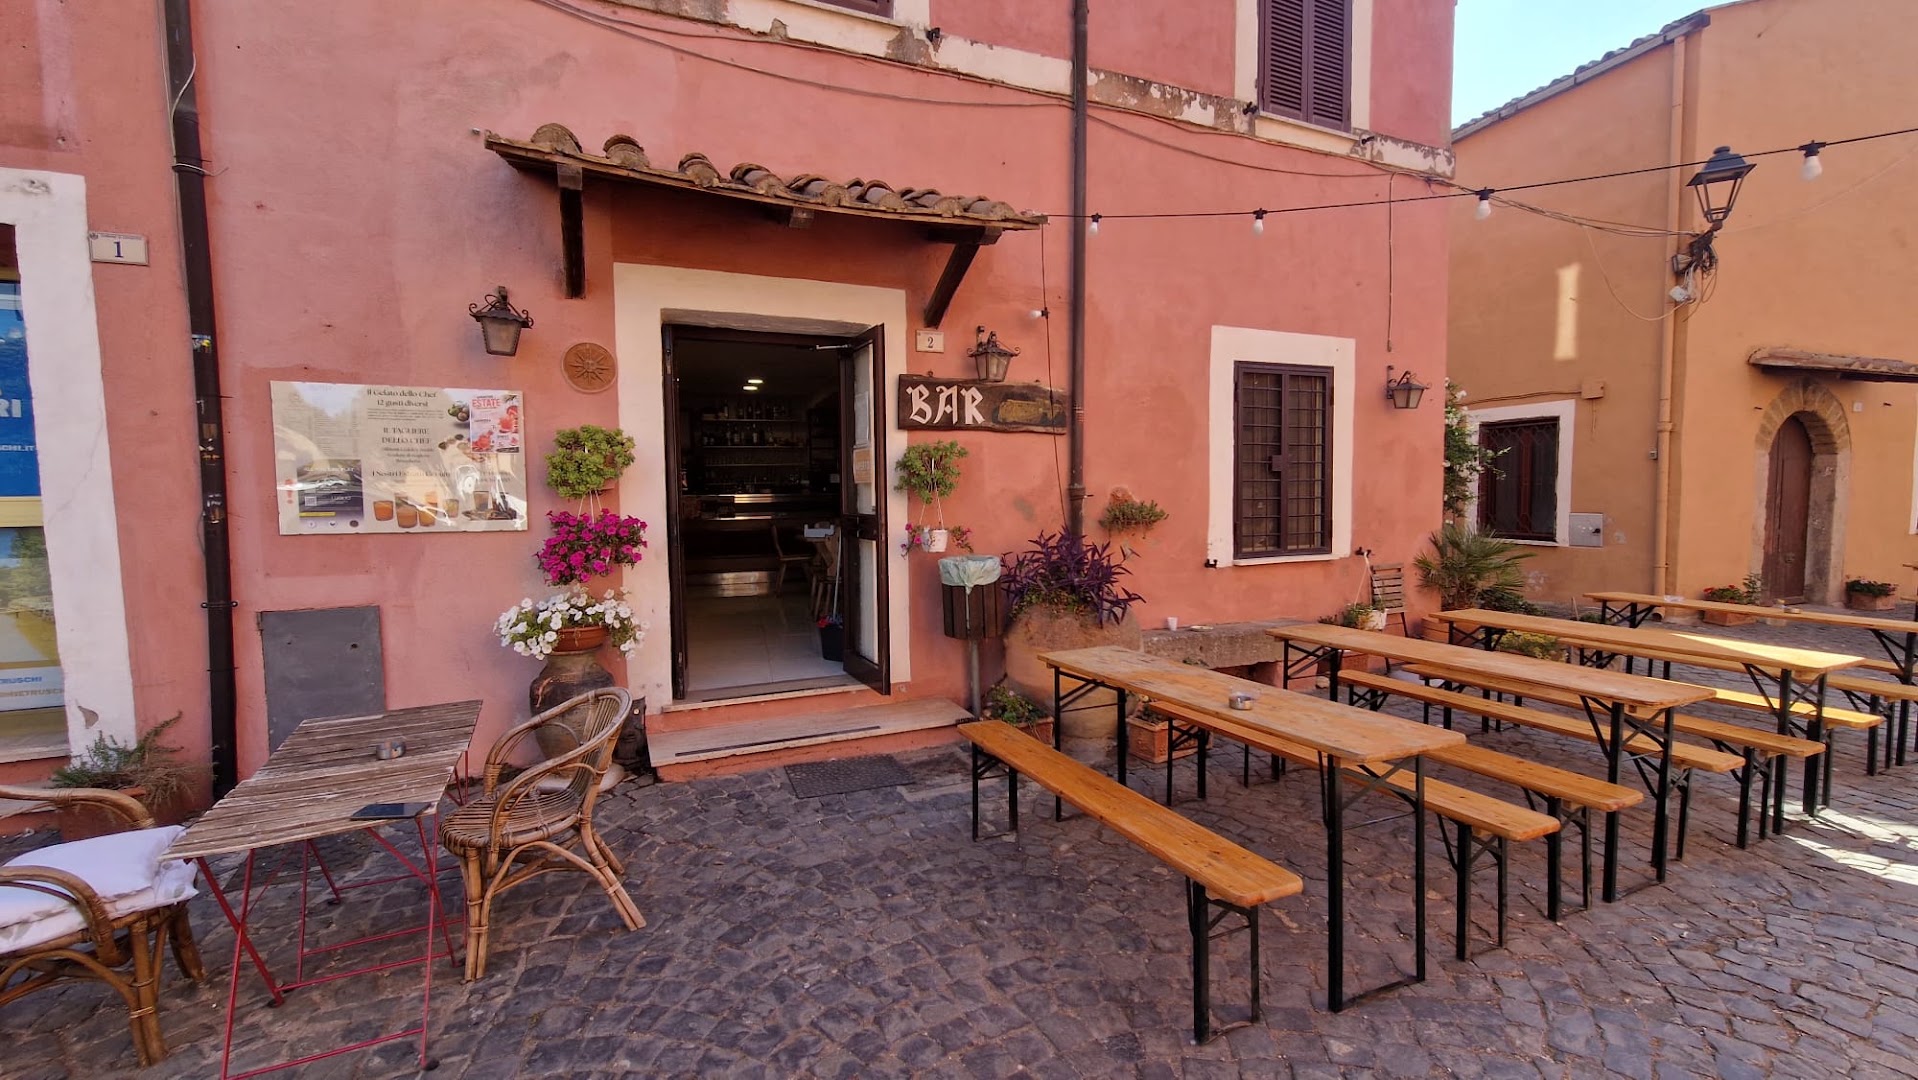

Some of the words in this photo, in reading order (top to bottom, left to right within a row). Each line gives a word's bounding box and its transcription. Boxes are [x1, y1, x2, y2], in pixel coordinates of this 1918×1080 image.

[114, 241, 124, 258] 1
[927, 336, 934, 349] 2
[472, 399, 500, 408] ESTATE
[905, 384, 985, 425] BAR
